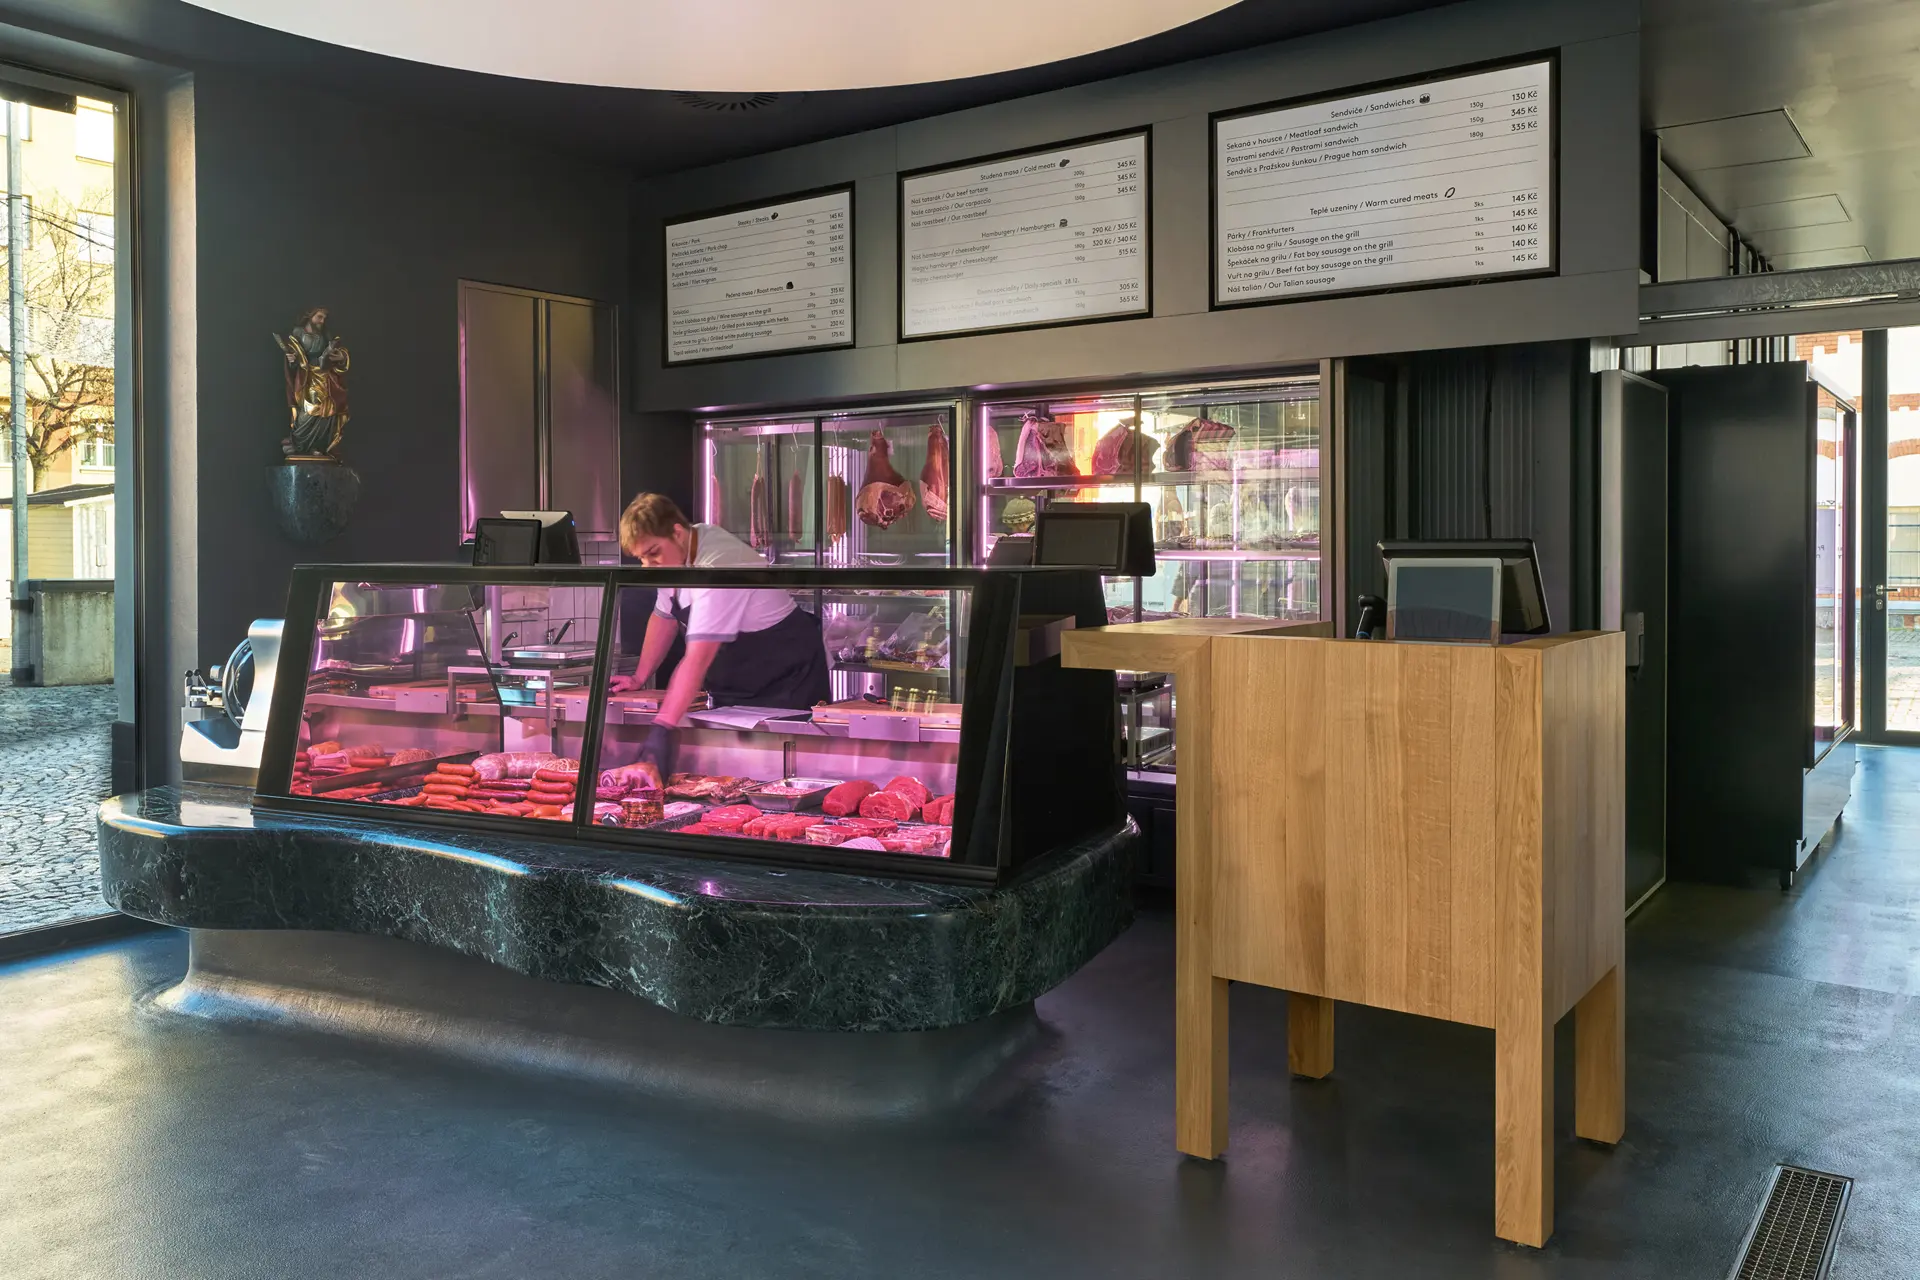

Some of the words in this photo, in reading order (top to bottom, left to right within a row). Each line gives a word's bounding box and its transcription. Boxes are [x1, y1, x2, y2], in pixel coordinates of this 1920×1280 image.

[1512, 92, 1526, 101] 130
[1528, 90, 1537, 98] Kč
[1370, 99, 1415, 111] Sandwiches
[1511, 107, 1526, 116] 345
[1528, 105, 1537, 113] Kč
[1511, 123, 1526, 131] 335
[1528, 121, 1537, 129] Kč
[1258, 136, 1282, 144] housce
[1289, 128, 1321, 139] Meatloaf
[1324, 121, 1358, 133] sandwich
[1227, 152, 1257, 163] Pastrami
[1291, 141, 1322, 153] Pastrami
[1325, 135, 1359, 147] sandwich
[1324, 153, 1350, 161] Prague
[1371, 142, 1407, 154] sandwich
[1330, 204, 1358, 212] uzeniny
[1365, 200, 1388, 208] Warm
[1390, 195, 1411, 204] cured
[1413, 192, 1438, 201] meats
[1512, 194, 1525, 202] 145
[1513, 209, 1525, 217] 145
[1252, 227, 1294, 236] Frankfurters
[1512, 224, 1526, 232] 140
[1528, 223, 1537, 231] Kč
[1266, 241, 1282, 250] grilu
[1289, 237, 1318, 245] Sausage
[1345, 231, 1359, 240] grill
[1512, 239, 1525, 247] 140
[1528, 238, 1537, 246] Kč
[1271, 254, 1287, 262] grilu
[1322, 247, 1351, 255] sausage
[1379, 241, 1393, 250] grill
[1528, 253, 1537, 261] Kč
[1254, 270, 1269, 278] grilu
[1276, 266, 1292, 274] Beef
[1378, 255, 1393, 264] grill
[1306, 277, 1335, 285] sausage
